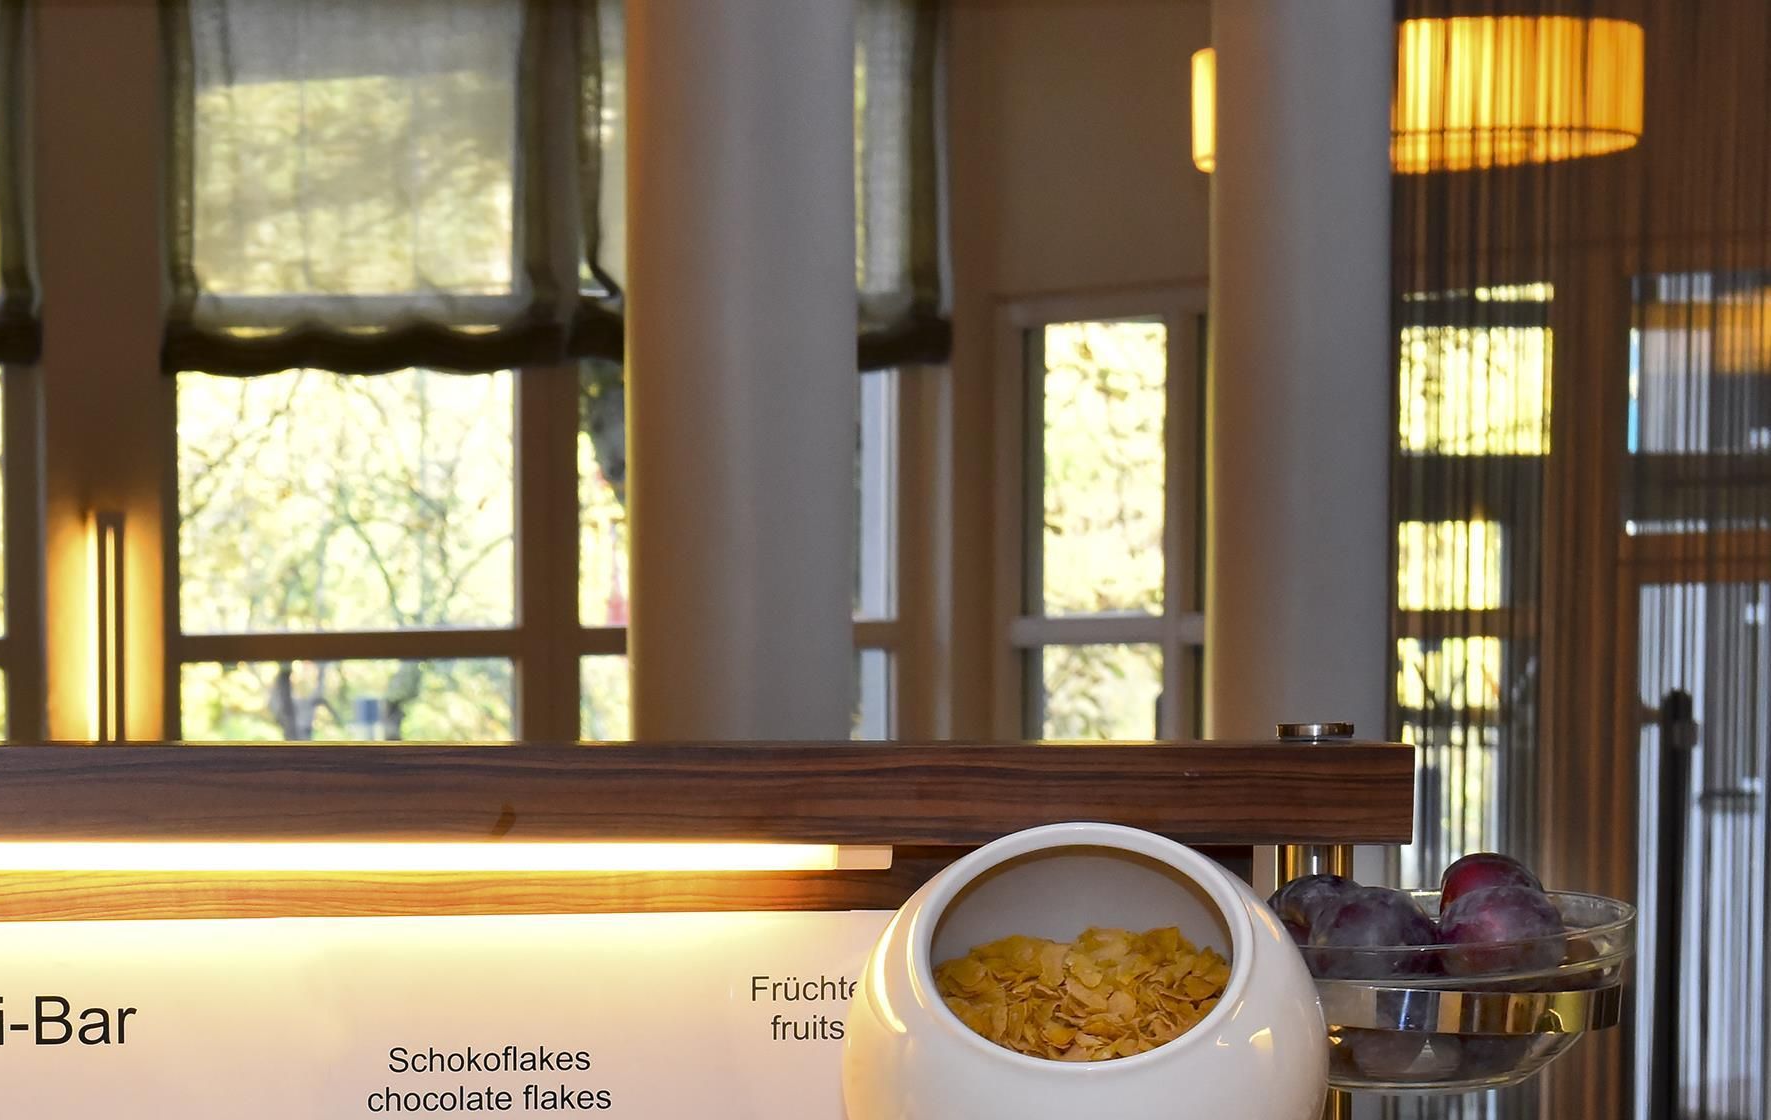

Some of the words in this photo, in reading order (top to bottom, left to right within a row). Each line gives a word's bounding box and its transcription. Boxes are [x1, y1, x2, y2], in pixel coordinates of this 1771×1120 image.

[771, 1014, 845, 1041] fruits
[388, 1045, 591, 1073] Schokoflakes
[367, 1086, 513, 1112] chocolate
[522, 1084, 612, 1110] flakes
